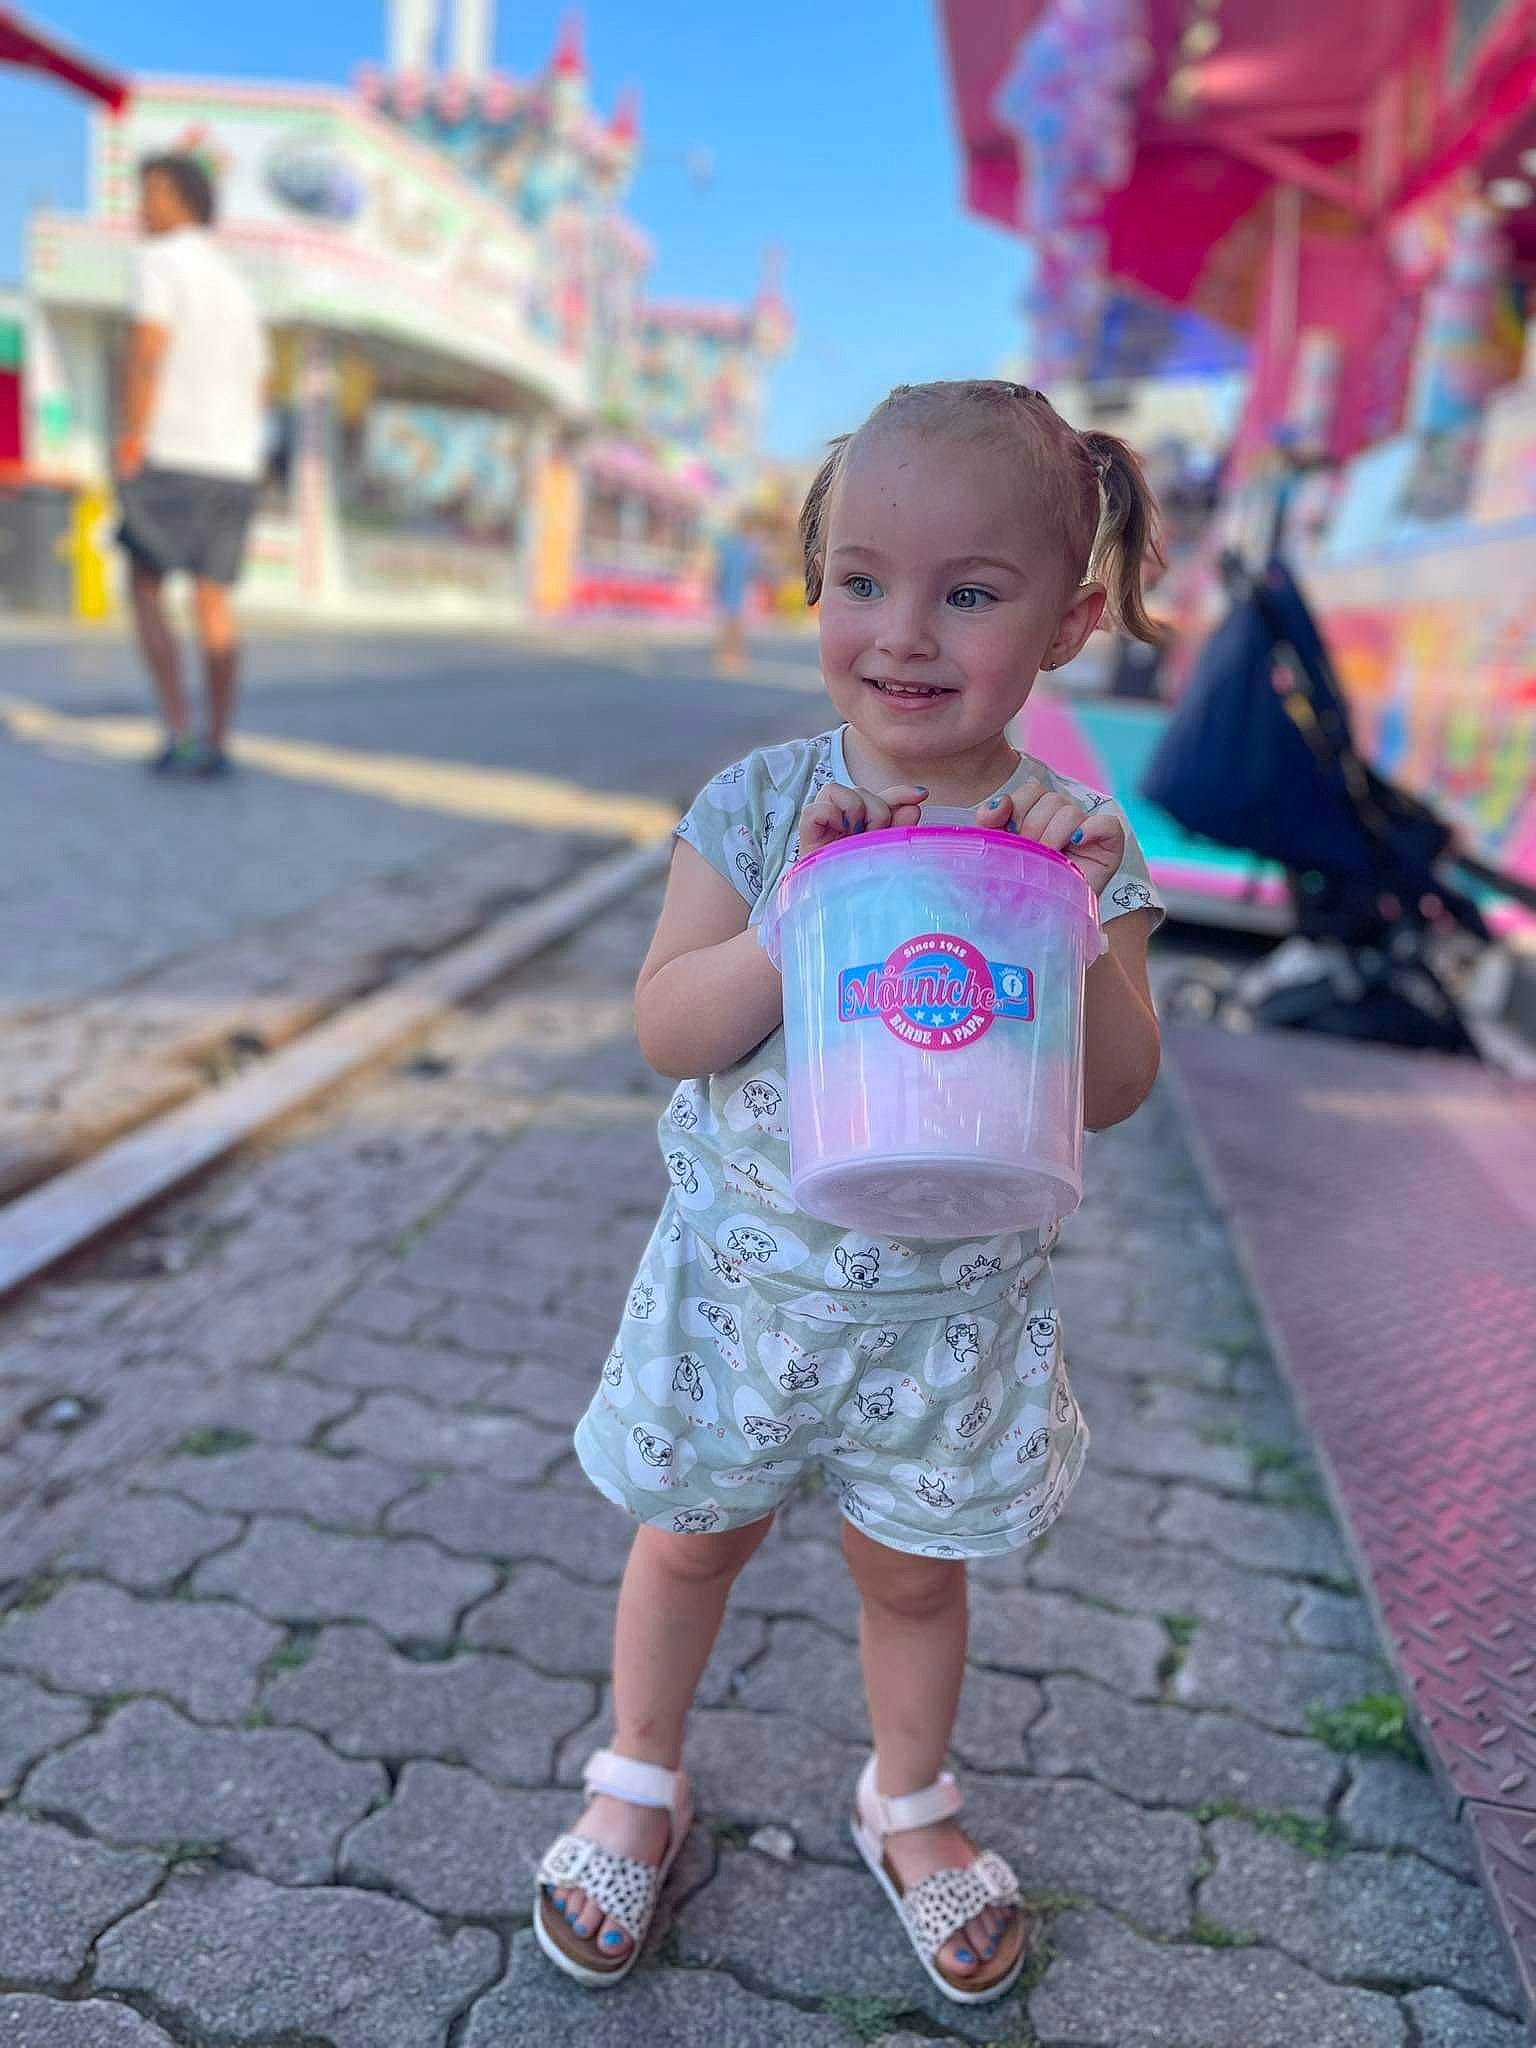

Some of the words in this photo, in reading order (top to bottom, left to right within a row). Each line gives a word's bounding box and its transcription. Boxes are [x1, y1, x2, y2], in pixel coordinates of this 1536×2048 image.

[903, 940, 936, 958] Since
[844, 967, 997, 1016] Mouniche
[952, 1014, 985, 1042] PAPA
